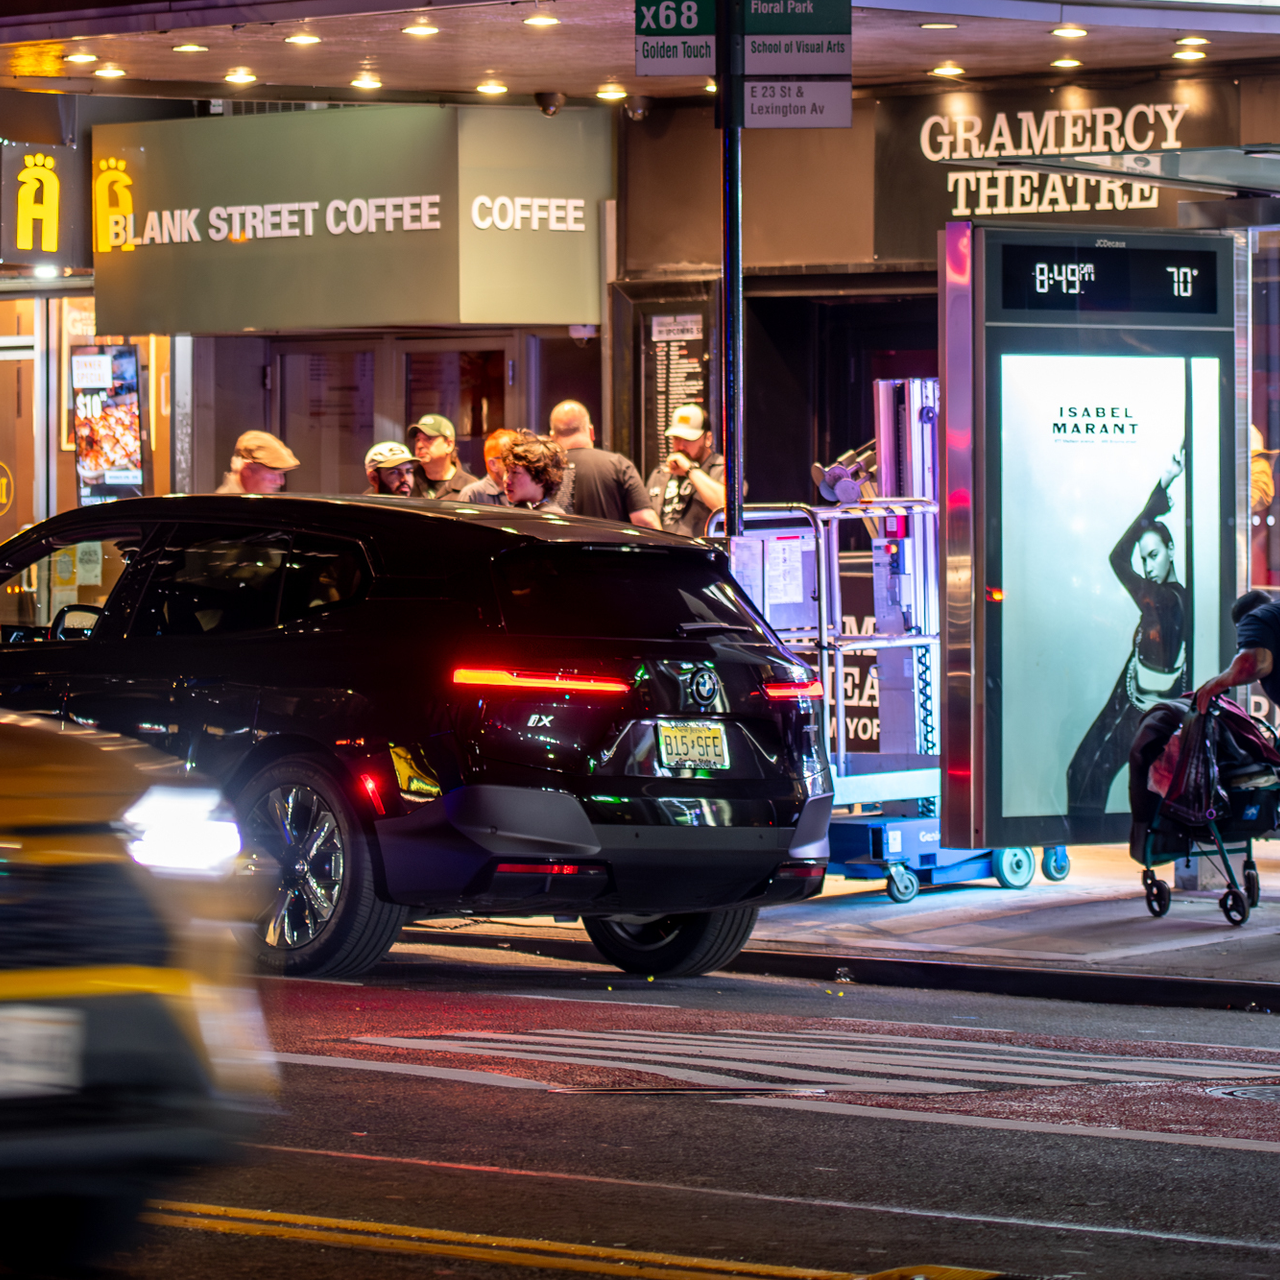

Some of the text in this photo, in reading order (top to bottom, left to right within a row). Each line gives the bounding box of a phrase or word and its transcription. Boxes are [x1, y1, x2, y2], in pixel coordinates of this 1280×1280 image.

[750, 0, 814, 14] Floral Park
[641, 40, 712, 60] Golden Touch
[750, 40, 846, 54] School of Visual Arts
[750, 86, 805, 99] E 23 St &
[750, 102, 825, 118] Lexington Av
[920, 103, 1190, 161] GRAMERCY
[947, 170, 1159, 217] THEATRE
[108, 195, 441, 246] BLANK STREET COFFEE
[471, 195, 586, 232] COFFEE
[1095, 239, 1126, 248] JCDecaux
[76, 360, 101, 370] DINNER
[76, 372, 106, 383] SPECIAL
[1059, 406, 1134, 419] ISABEL
[1052, 423, 1139, 436] MARANT
[664, 735, 722, 757] B15 SFE
[919, 831, 940, 842] Geni
